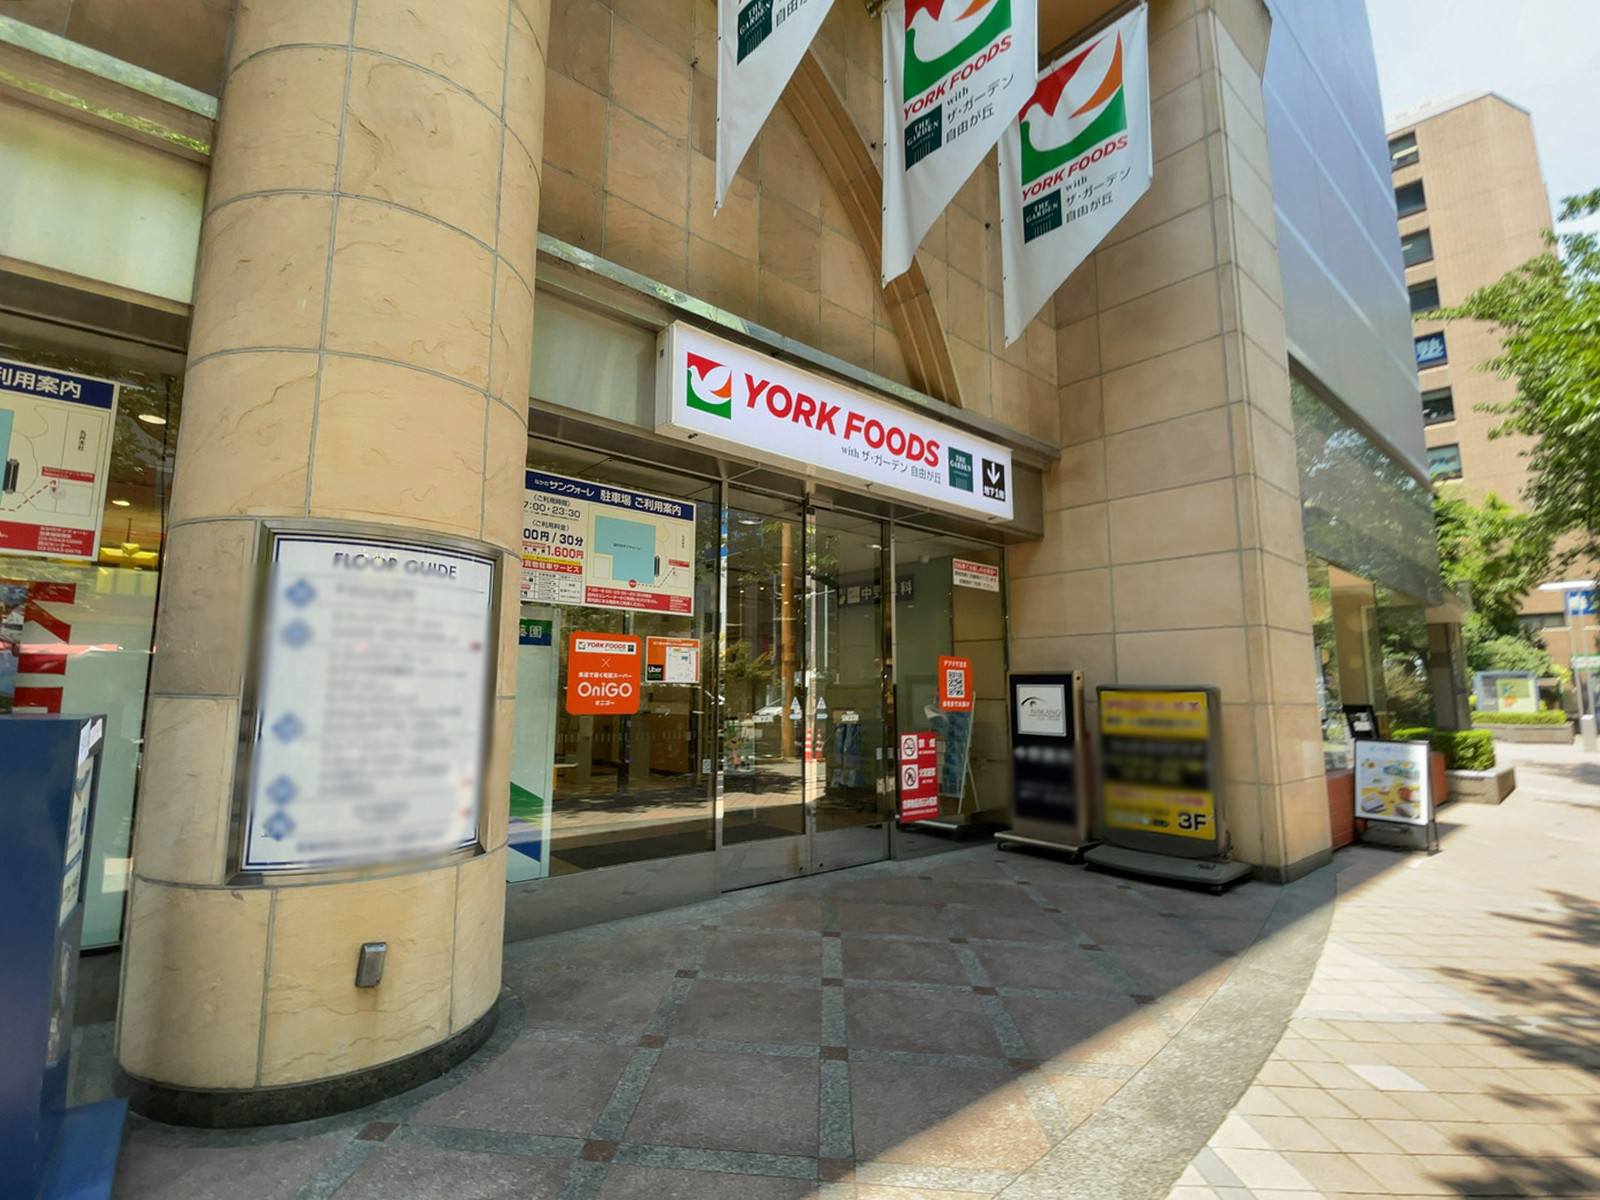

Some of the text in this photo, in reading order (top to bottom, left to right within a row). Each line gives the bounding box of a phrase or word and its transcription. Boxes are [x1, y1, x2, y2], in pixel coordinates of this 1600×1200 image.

[904, 34, 1012, 121] YORK FOODS
[946, 72, 1014, 124] ザ・ガーデン
[947, 86, 969, 106] with
[907, 120, 939, 146] GARDEN
[914, 117, 931, 132] THE
[946, 102, 995, 143] 自由が丘
[1022, 134, 1128, 201] YORK FOODS
[1065, 176, 1088, 191] with
[1066, 166, 1131, 207] ザ・ガーデン
[1025, 202, 1059, 223] GARDEN
[1034, 200, 1049, 212] THE
[1066, 191, 1112, 223] 自由が丘
[0, 366, 82, 399] 利用案内
[744, 373, 940, 467] YORK FOODS
[841, 445, 942, 484] with ザ・ガーデン 自由が丘
[949, 459, 972, 473] GARDEN
[955, 454, 966, 464] THE
[600, 489, 632, 507] 駐車場
[634, 497, 682, 516] ご利用案内
[559, 533, 584, 547] 30分
[403, 559, 457, 580] GUIDE
[648, 665, 662, 673] Uber
[577, 681, 632, 697] OniGO
[1177, 811, 1206, 831] 3F
